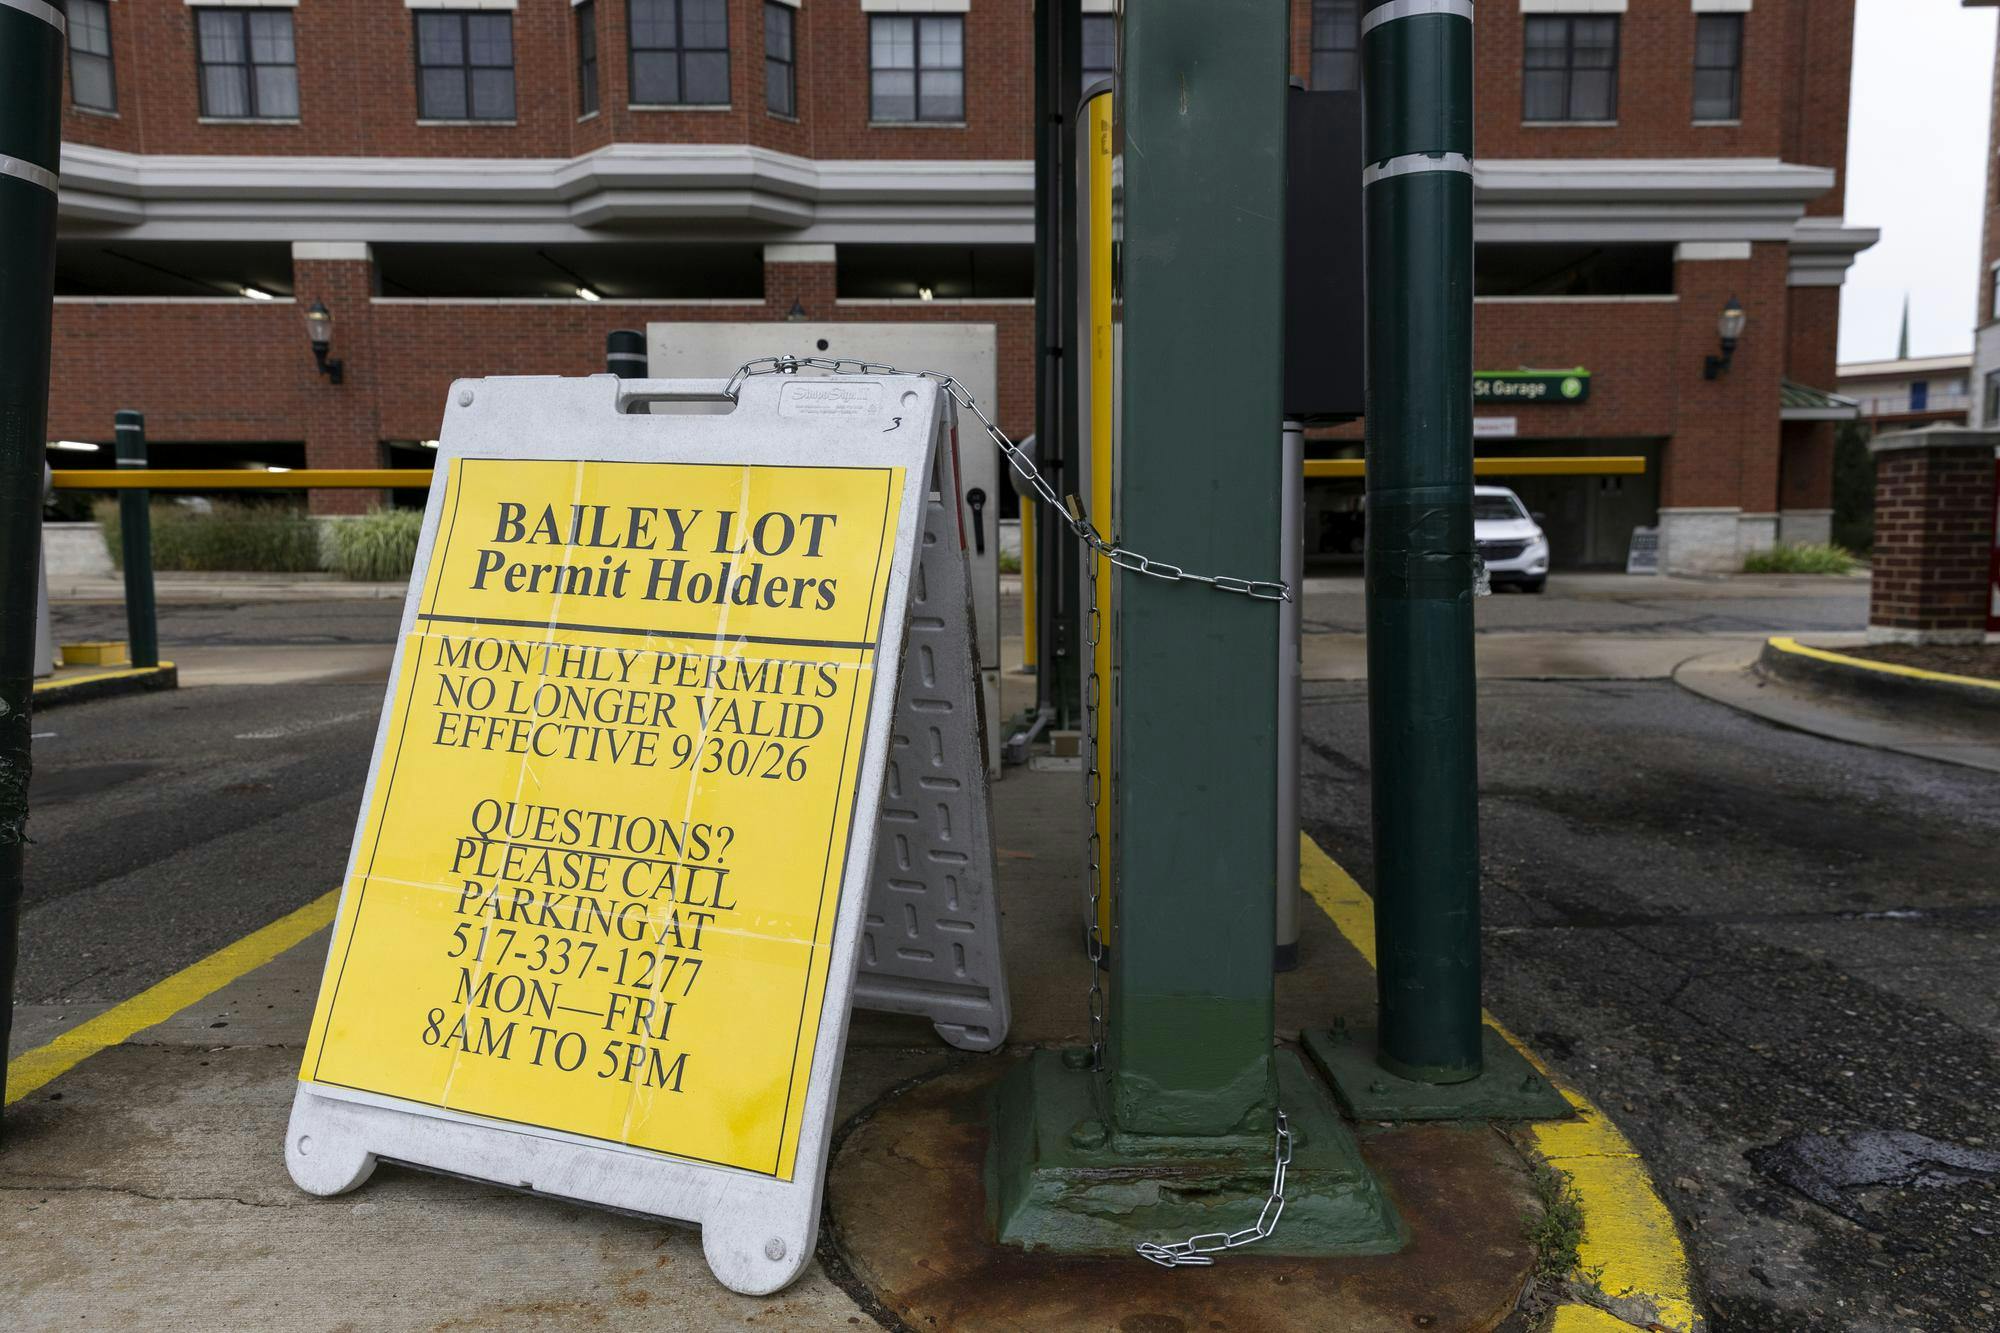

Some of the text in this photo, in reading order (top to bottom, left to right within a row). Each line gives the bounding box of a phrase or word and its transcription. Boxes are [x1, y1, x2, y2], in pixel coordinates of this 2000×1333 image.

[1474, 379, 1547, 399] St Garage
[491, 502, 838, 558] BAILEY LOT
[469, 548, 838, 611] Permit Holders
[433, 635, 841, 699] MONTHLY PERMITS
[433, 674, 825, 741] NO LONGER VALID
[433, 711, 808, 783] EFFECTIVE 9/30/26
[470, 797, 735, 866] QUESTIONS?
[448, 837, 737, 911] PLEASE CALL
[454, 879, 715, 951] PARKING AT
[447, 922, 703, 998] 517-337-1277
[422, 1007, 691, 1094] 8AM TO 5PM
